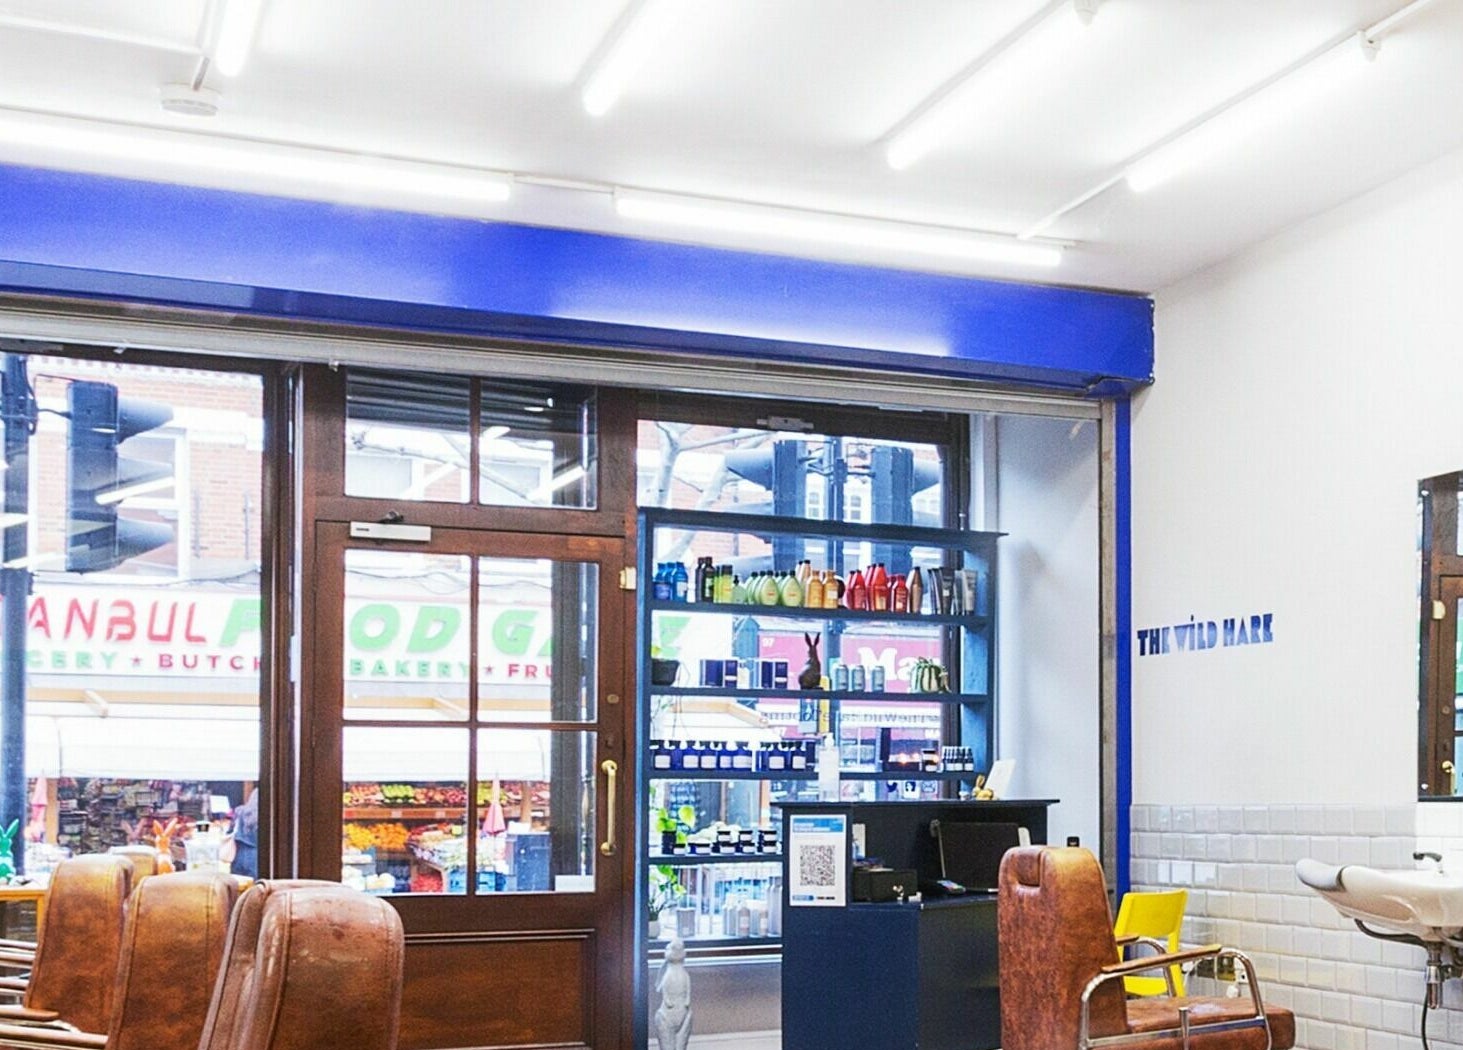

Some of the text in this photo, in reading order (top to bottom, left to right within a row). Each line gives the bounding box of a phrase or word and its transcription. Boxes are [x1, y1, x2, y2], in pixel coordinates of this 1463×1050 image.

[27, 596, 207, 643] ANBUL
[1137, 627, 1170, 656] THE
[1224, 613, 1273, 647] HARE
[27, 650, 118, 669] CERY
